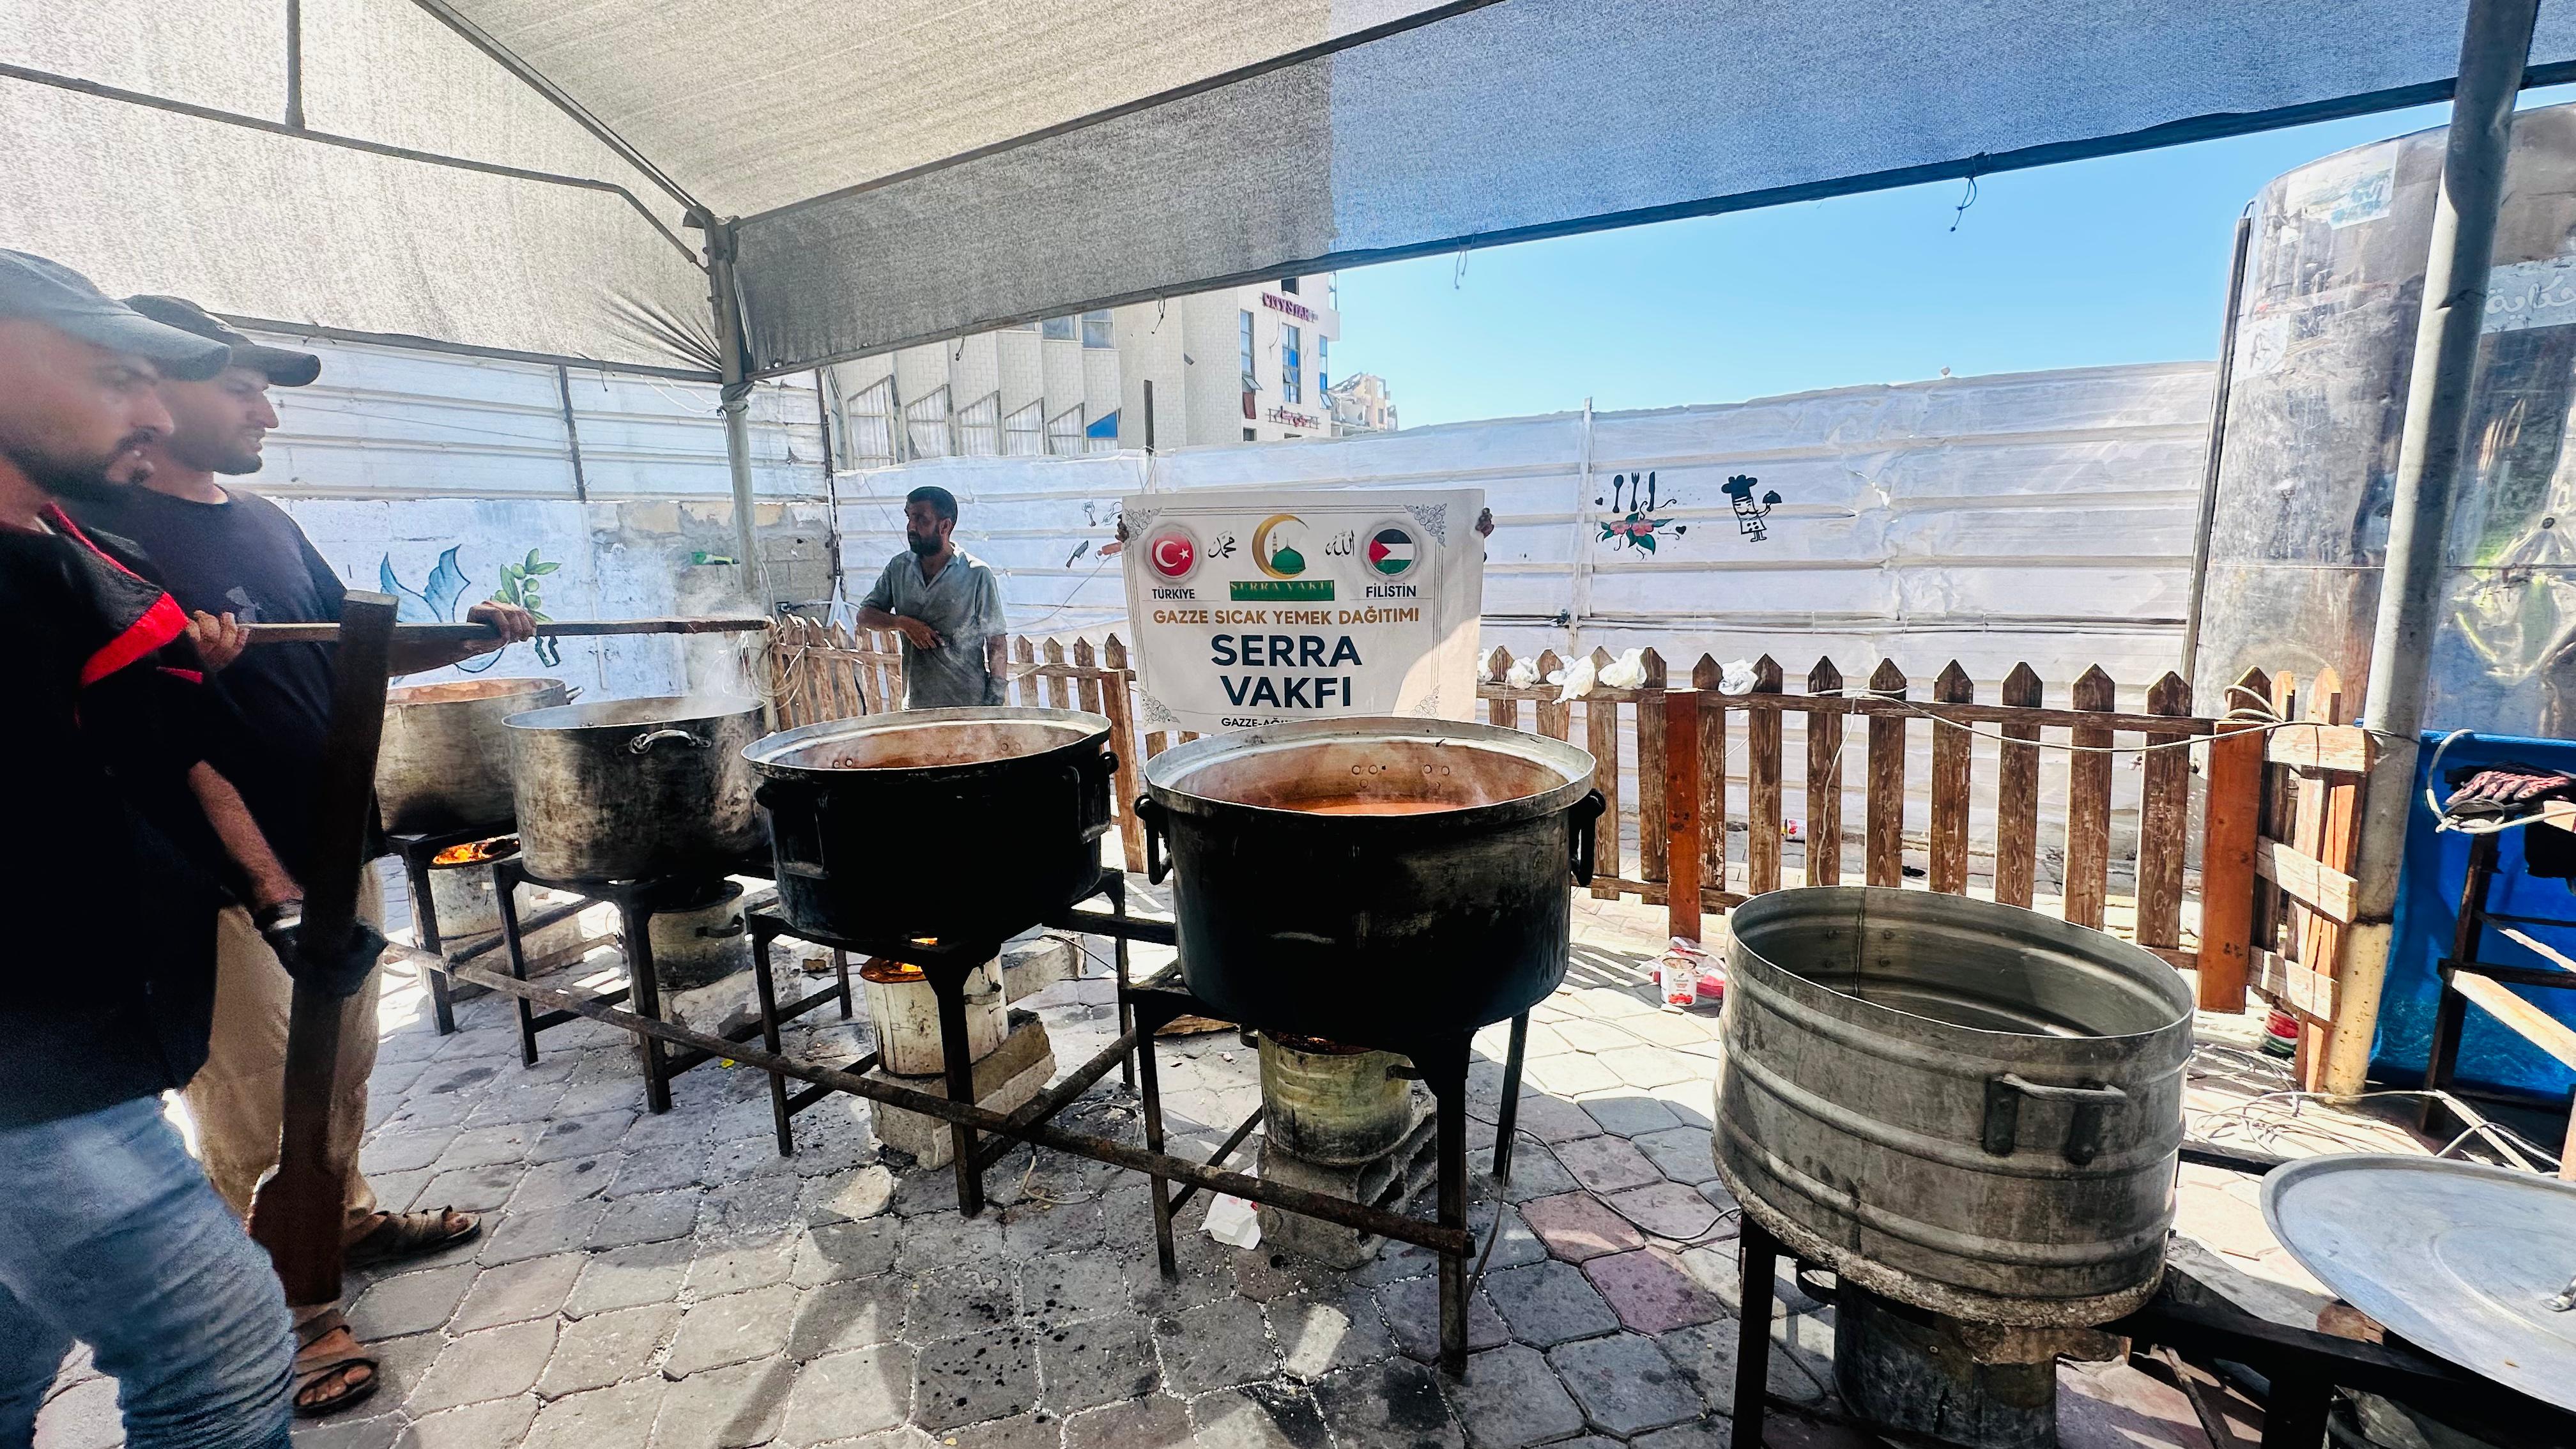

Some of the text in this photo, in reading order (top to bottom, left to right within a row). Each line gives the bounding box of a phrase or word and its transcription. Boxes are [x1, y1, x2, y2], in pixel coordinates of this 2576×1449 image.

[1152, 586, 1195, 600] TÜRKİYE
[1366, 582, 1416, 598] FİLİSTİN
[1153, 606, 1420, 625] GAZZE SICAK YEMEK DAĞITIMI
[1211, 634, 1363, 668] SERRA
[1219, 675, 1351, 709] VAKFI
